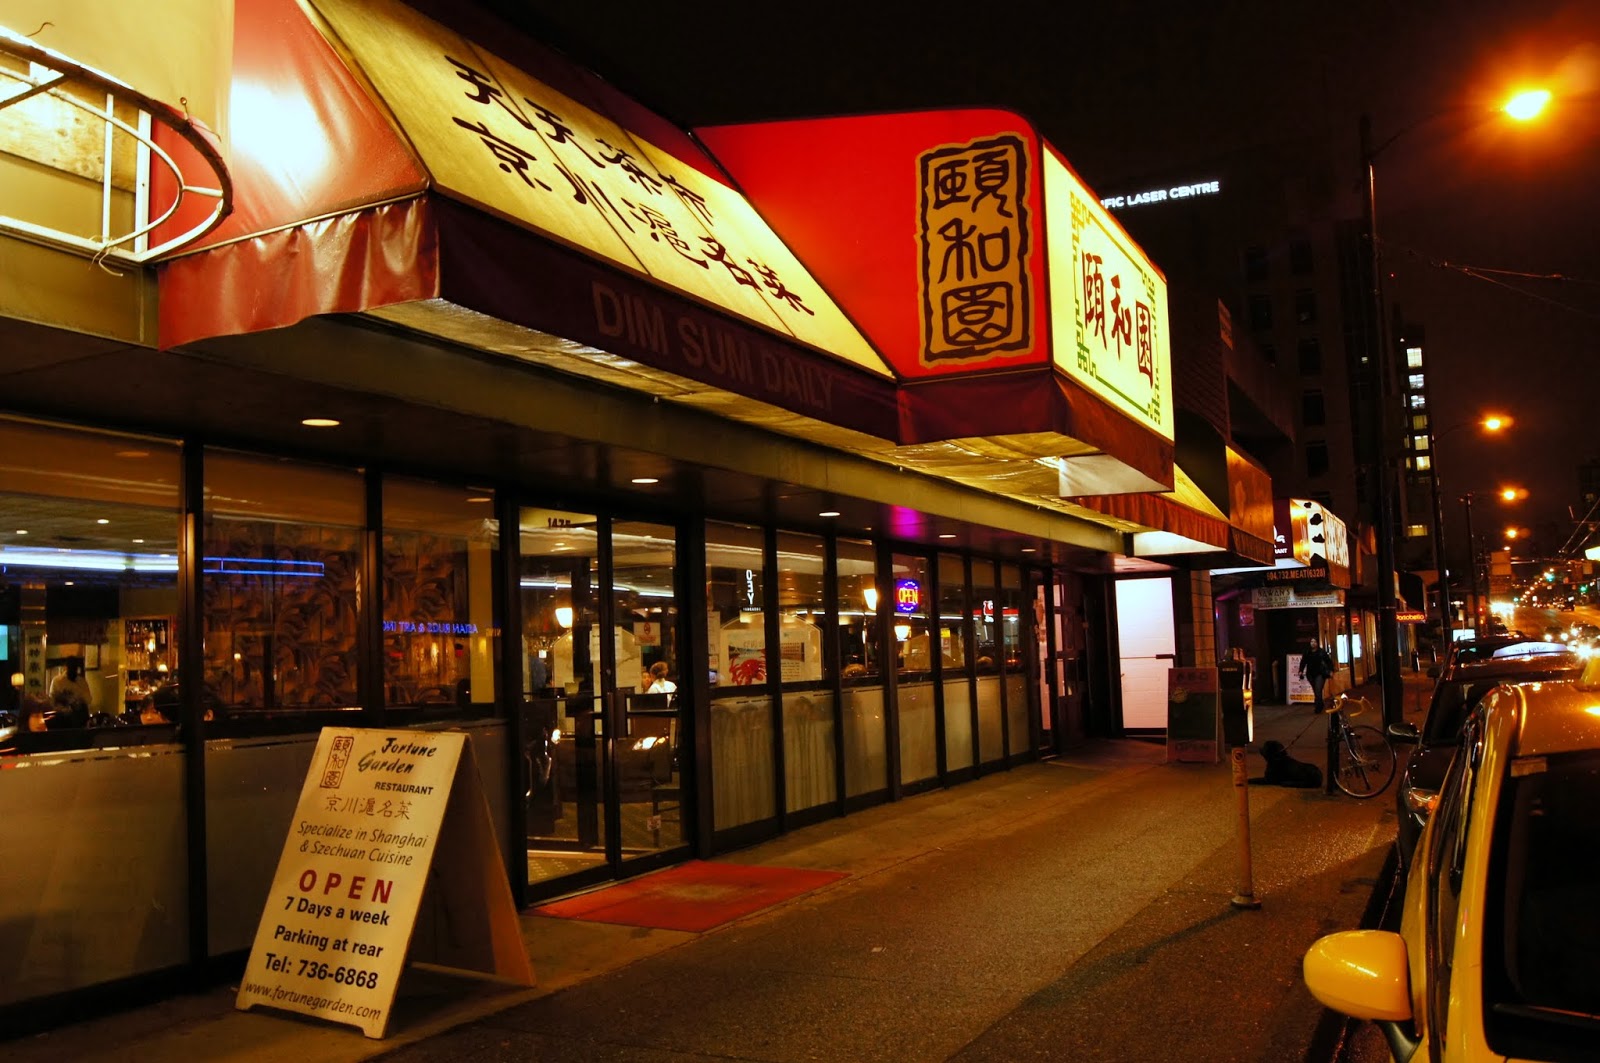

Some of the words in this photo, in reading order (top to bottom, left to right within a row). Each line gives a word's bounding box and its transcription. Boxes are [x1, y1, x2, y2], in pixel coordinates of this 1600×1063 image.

[1100, 196, 1125, 209] IFIC
[1127, 189, 1168, 206] LASER
[1169, 180, 1220, 199] CENTRE
[592, 280, 669, 356] DIM
[678, 317, 755, 384] SUM
[761, 352, 834, 411] DAILY
[898, 588, 919, 603] OPEN
[381, 737, 437, 757] Fortune
[357, 751, 414, 773] Garden
[374, 781, 433, 795] RESTAURANT
[297, 820, 352, 839] Specialize
[355, 827, 366, 840] in
[370, 829, 428, 848] Shanghai
[300, 839, 309, 852] &
[311, 840, 365, 860] Szechuan
[368, 848, 413, 866] Cuisine
[299, 869, 393, 904] OPEN
[284, 896, 294, 910] 7
[297, 898, 332, 919] Days
[335, 907, 345, 919] a
[350, 909, 390, 926] week
[274, 925, 329, 952] Parking
[332, 937, 349, 952] at
[352, 942, 383, 957] rear
[265, 953, 292, 974] Tel:
[297, 959, 378, 989] 736-6868
[245, 982, 382, 1020] www.fortunegarden.com
